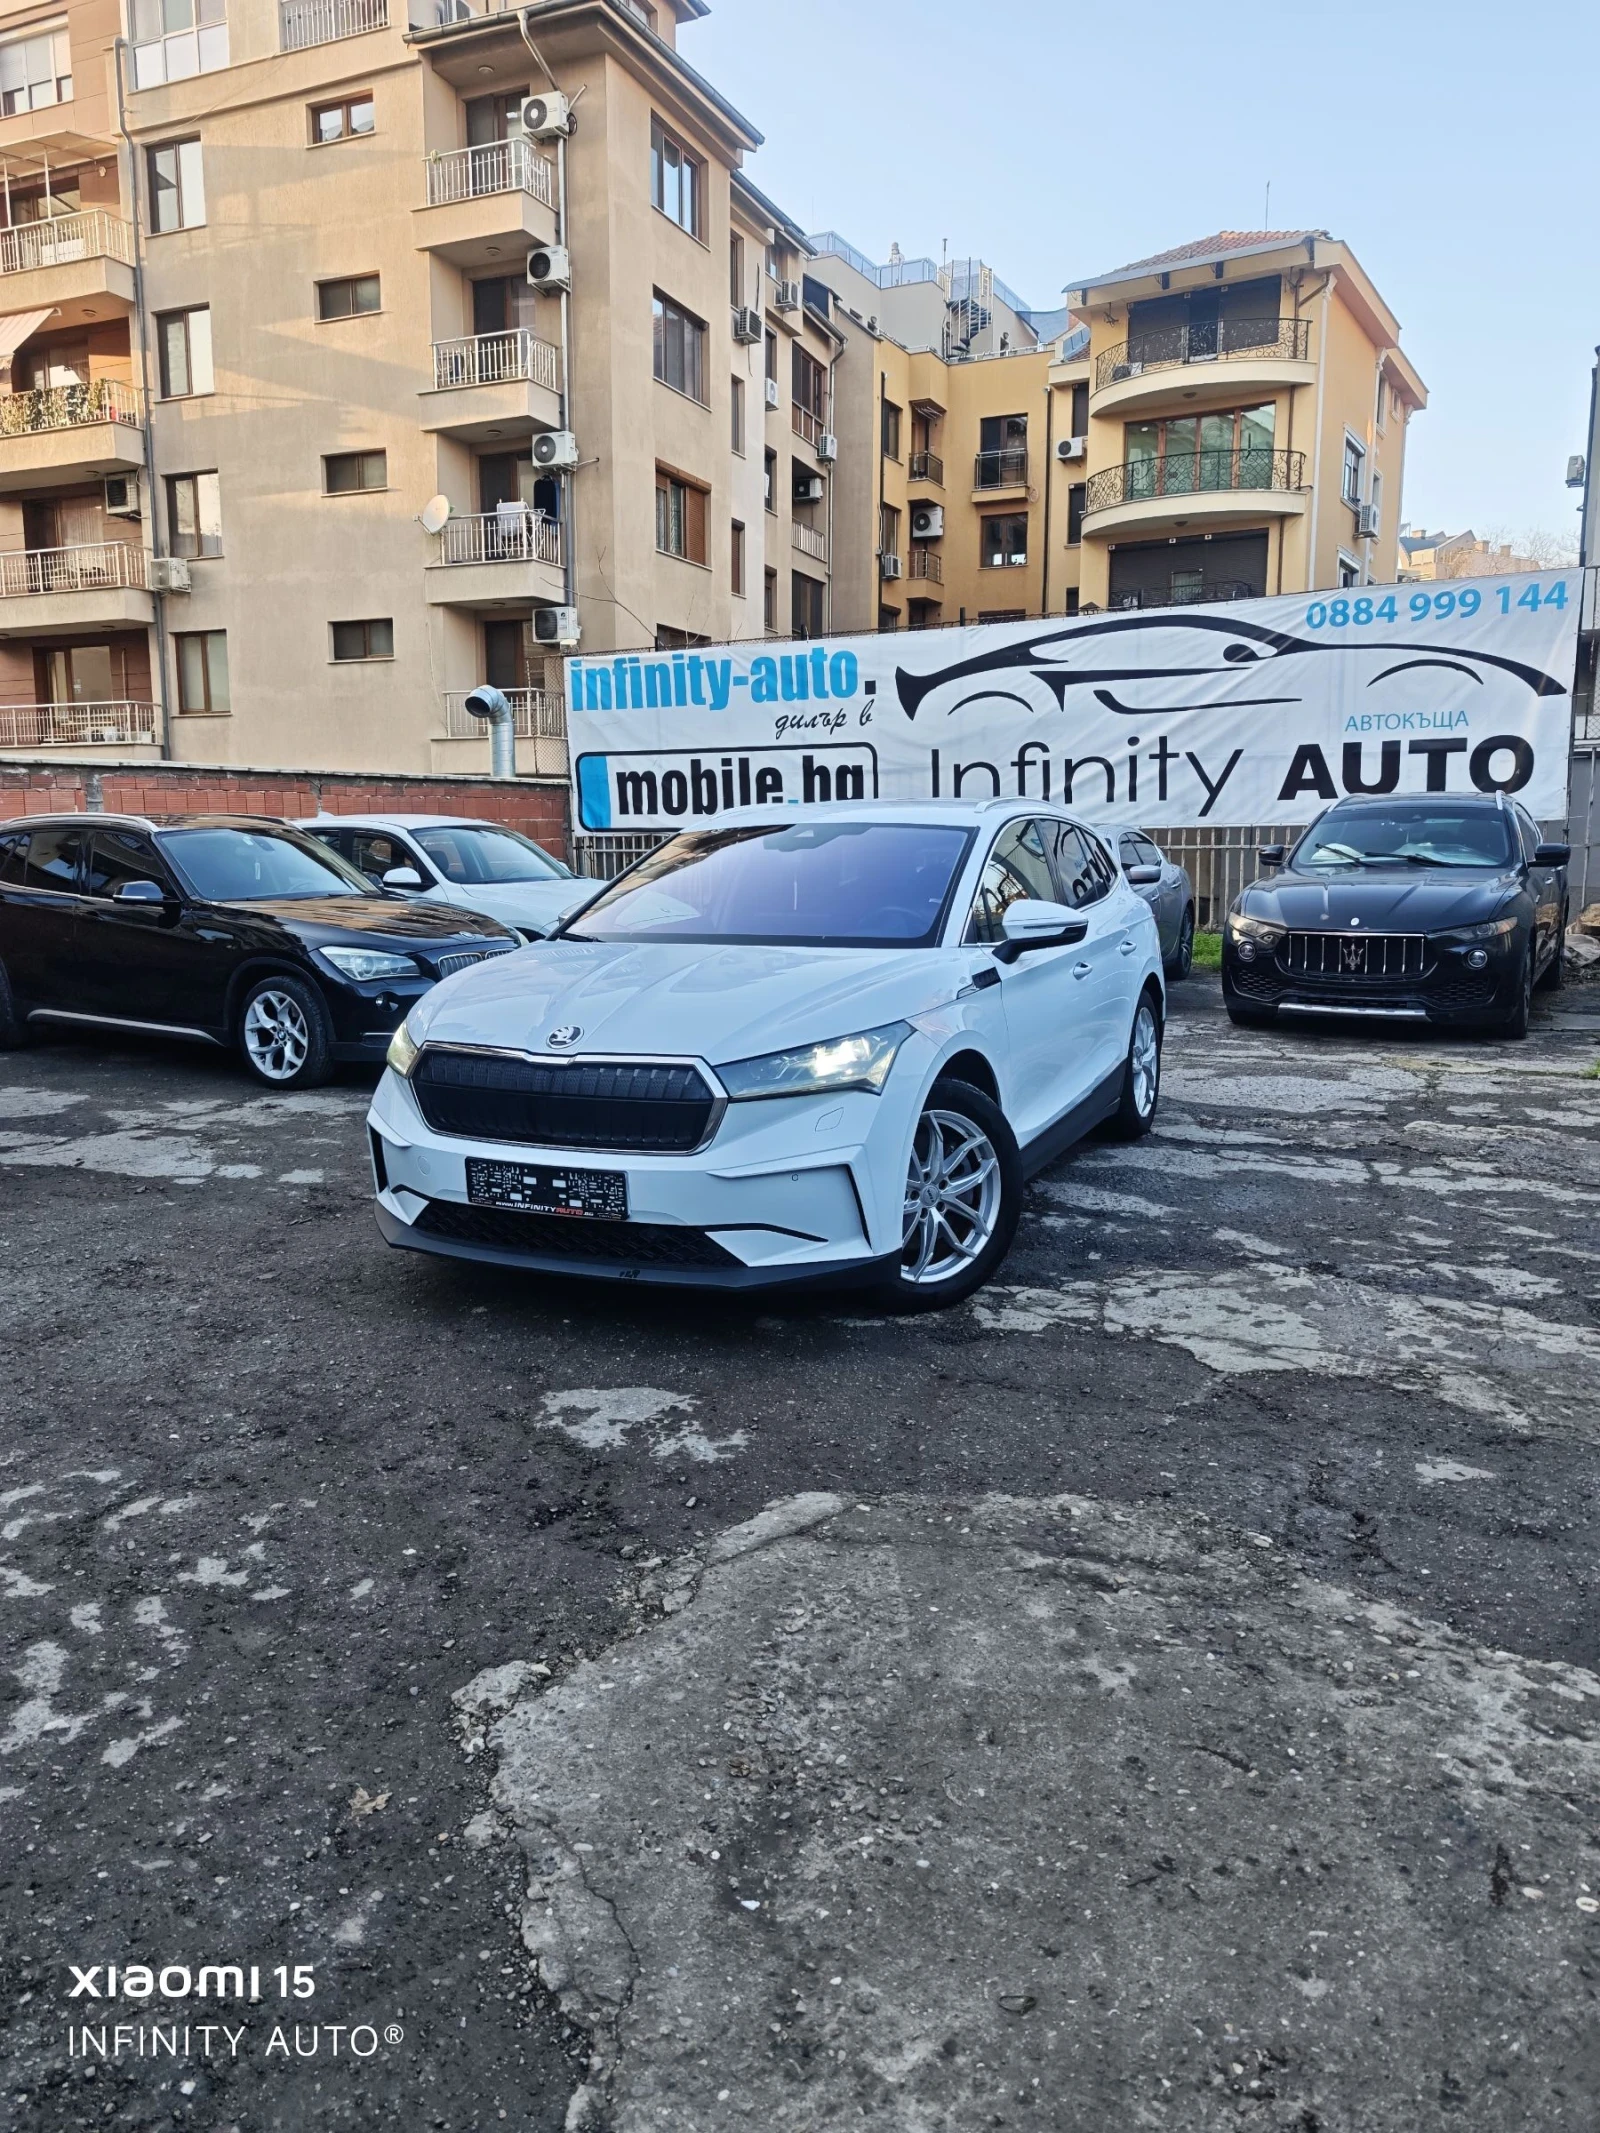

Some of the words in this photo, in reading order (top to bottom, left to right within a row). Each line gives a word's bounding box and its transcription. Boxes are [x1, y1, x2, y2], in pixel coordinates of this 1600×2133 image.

[1306, 595, 1398, 629] 0884
[1409, 588, 1481, 622] 999
[1496, 581, 1568, 614] 144
[775, 707, 848, 740] дилър
[859, 698, 875, 727] в
[1345, 711, 1469, 732] АВТОКЪЩА
[931, 735, 1244, 817] Infinity
[1277, 735, 1534, 801] AUTO
